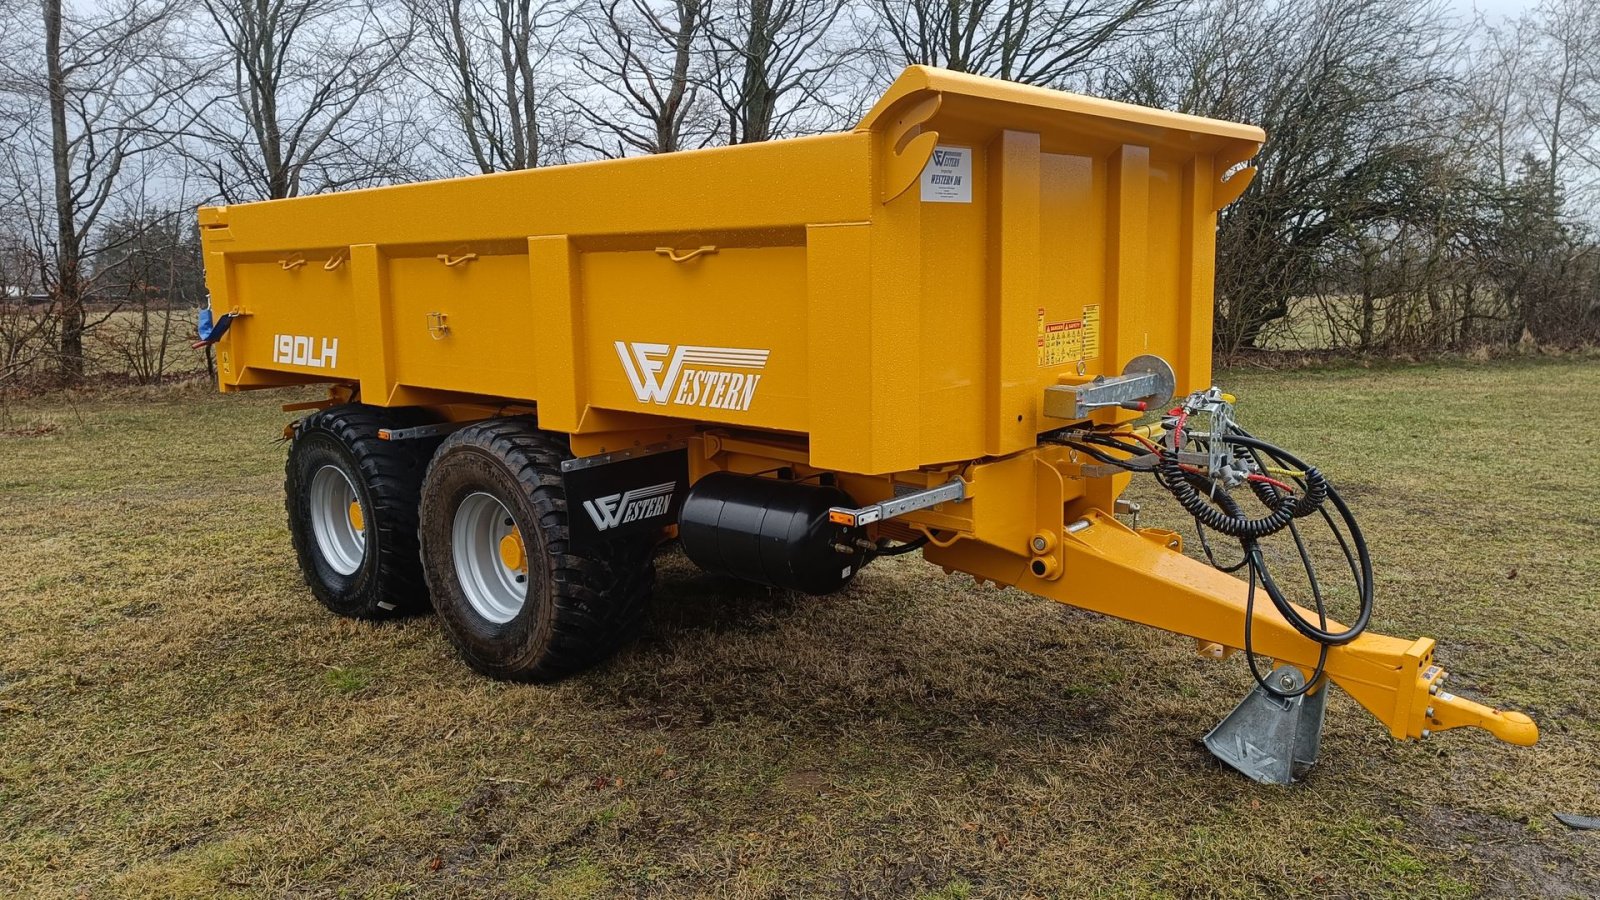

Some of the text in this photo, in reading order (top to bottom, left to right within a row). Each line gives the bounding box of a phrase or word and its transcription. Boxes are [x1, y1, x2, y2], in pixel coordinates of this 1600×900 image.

[932, 150, 961, 168] WESTERN
[931, 174, 954, 185] WESTERN
[613, 341, 762, 412] WESTERN
[582, 490, 674, 532] WESTERN
